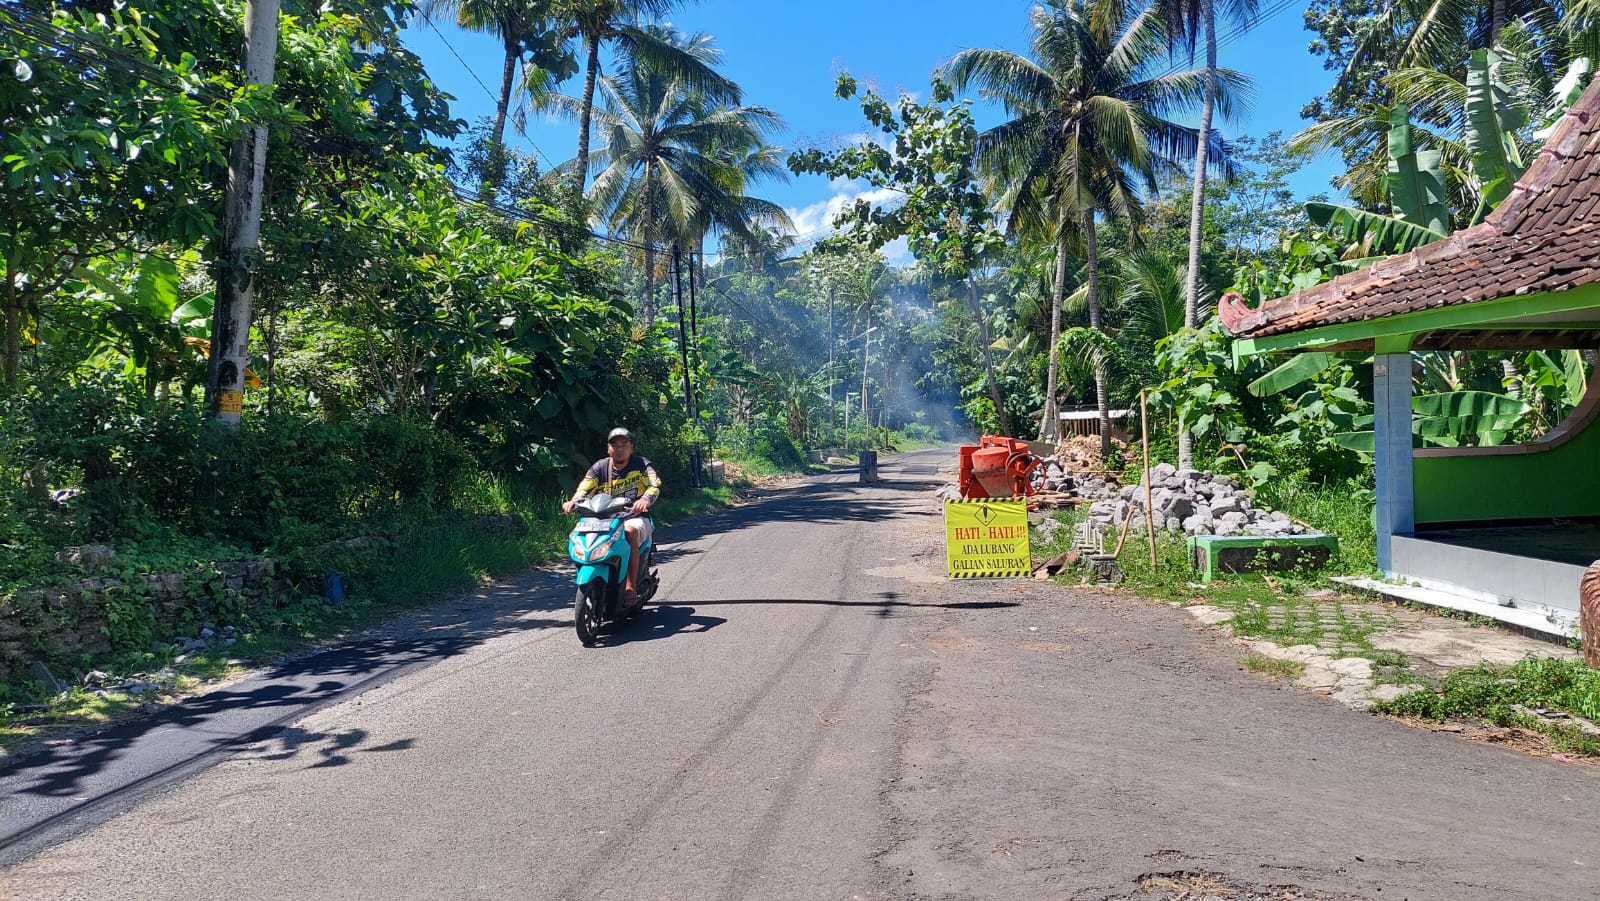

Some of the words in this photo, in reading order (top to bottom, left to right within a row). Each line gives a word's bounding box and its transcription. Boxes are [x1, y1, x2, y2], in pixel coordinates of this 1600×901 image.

[955, 527, 980, 540] HATI
[989, 526, 1014, 539] HATI
[962, 544, 978, 554] ADA
[981, 543, 1015, 554] LUBANG
[953, 560, 984, 569] GALIAN
[987, 559, 1025, 569] SALURAN
